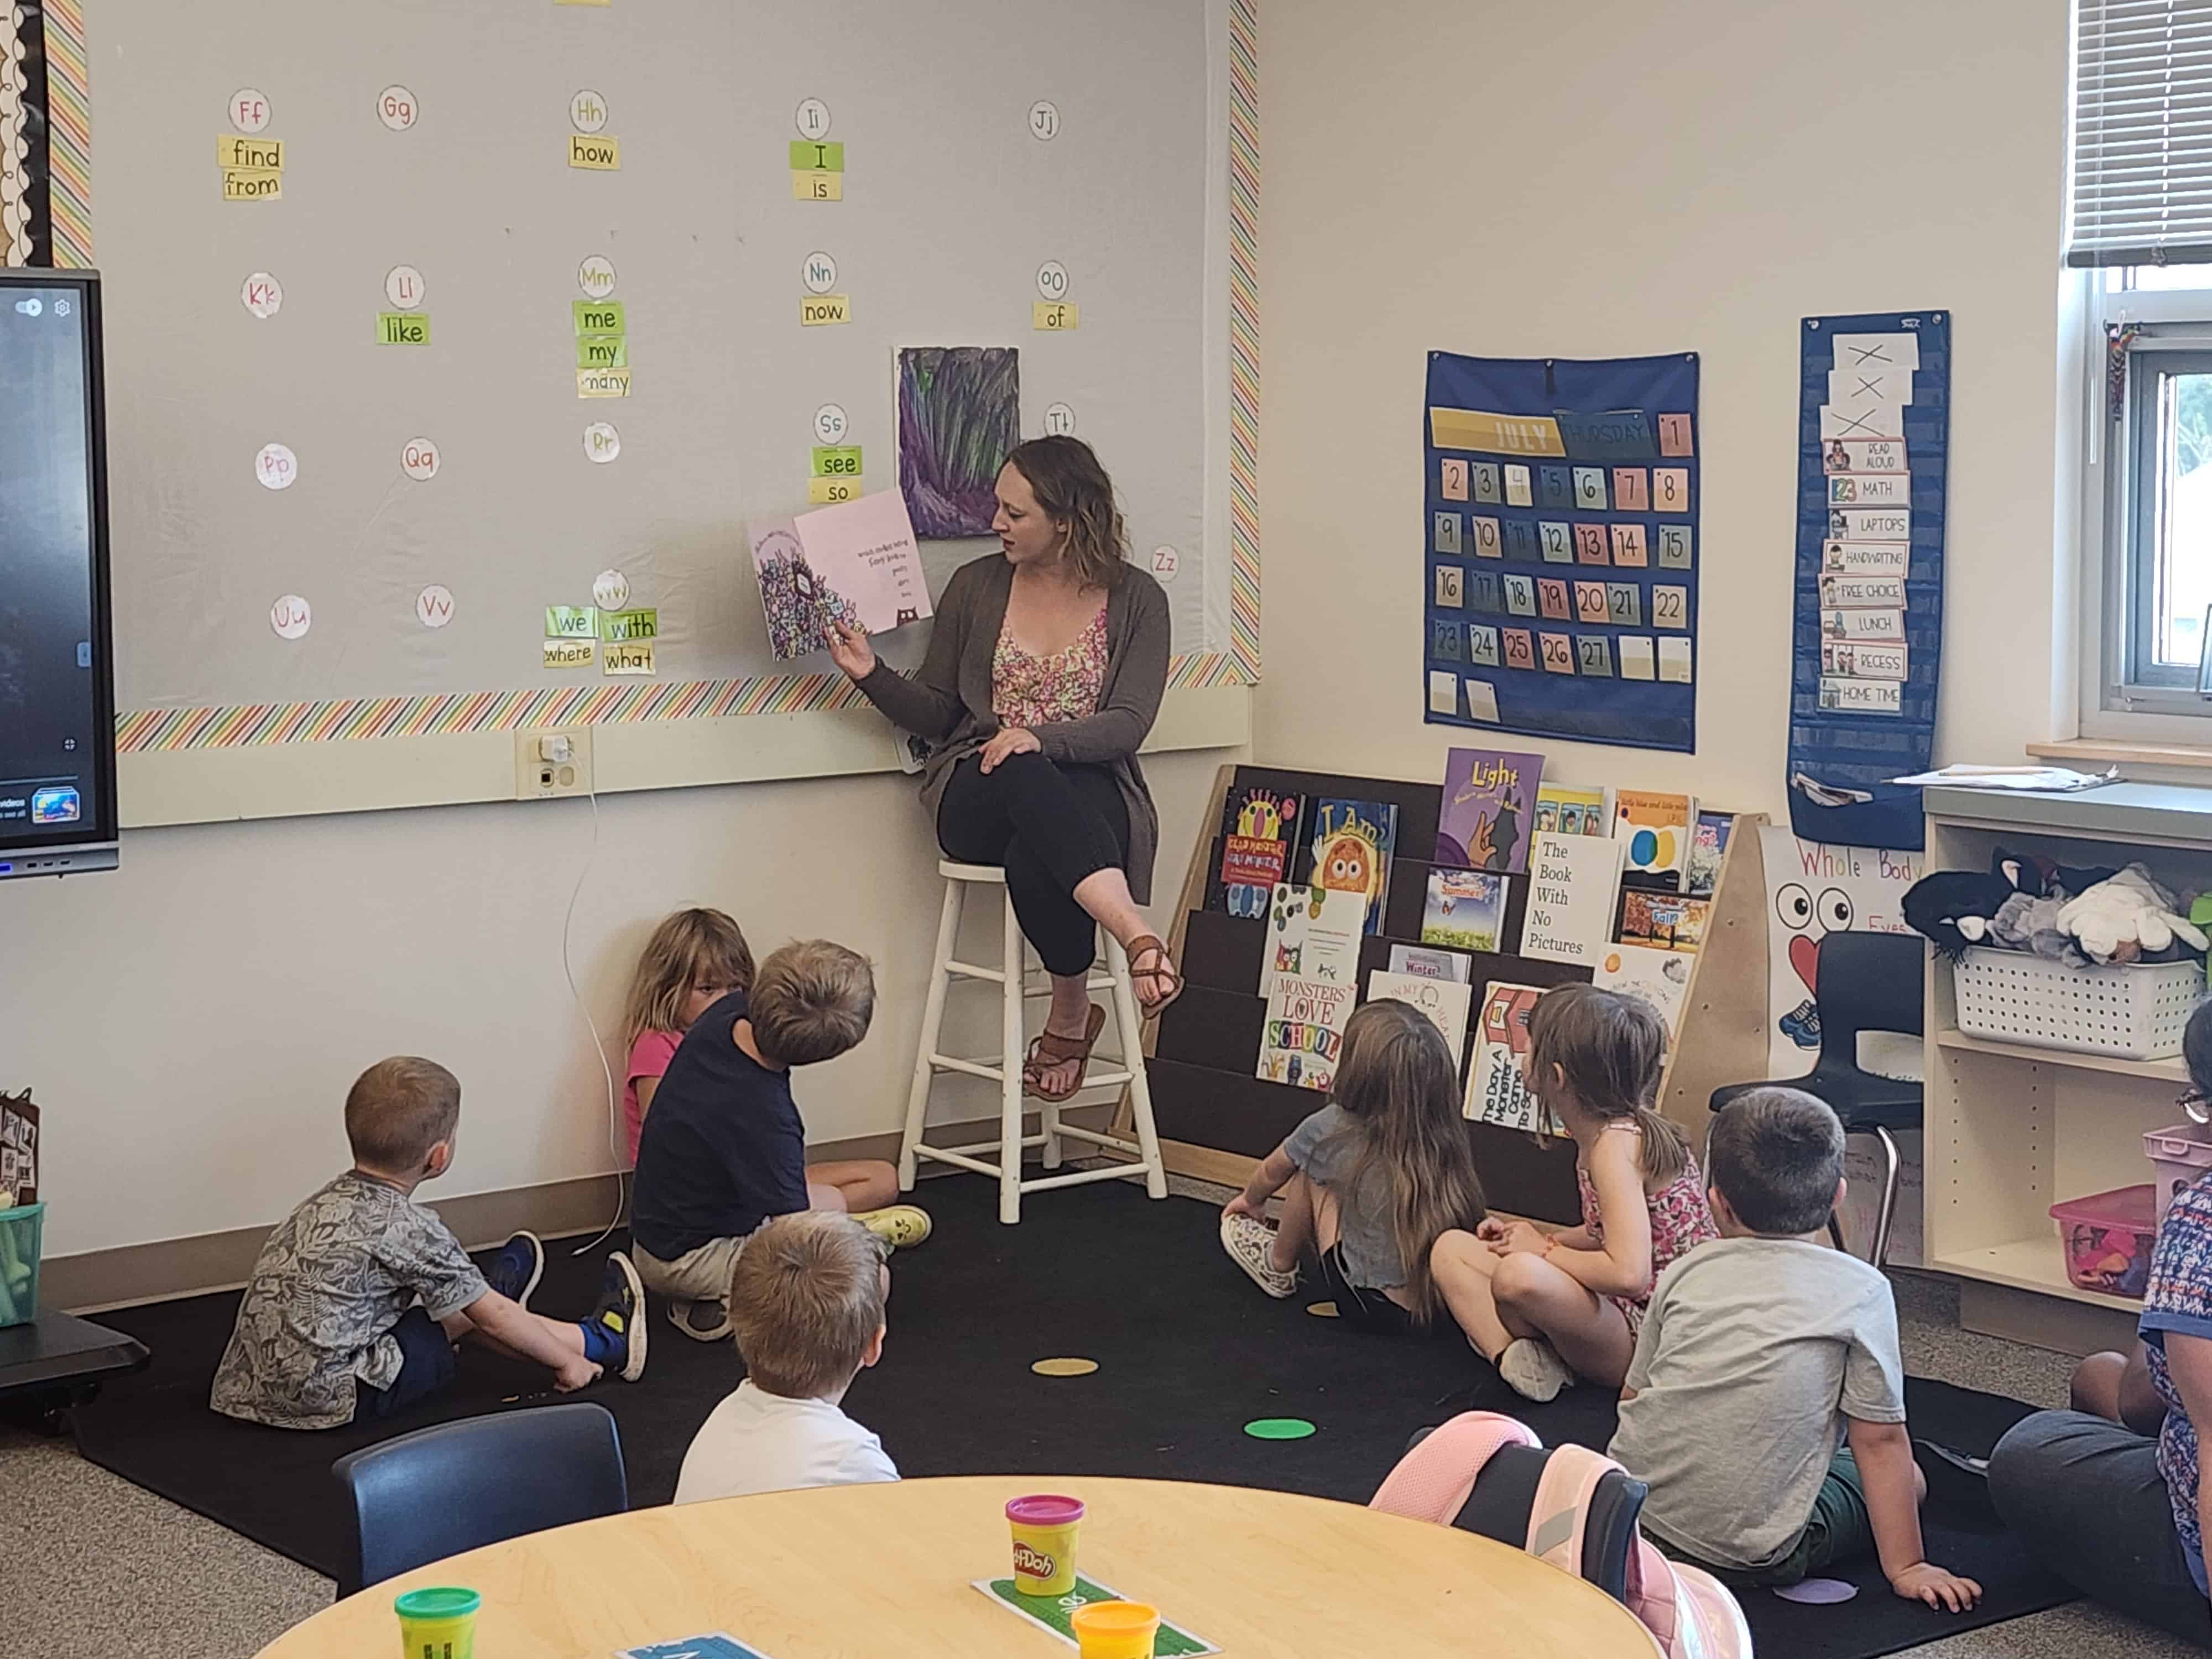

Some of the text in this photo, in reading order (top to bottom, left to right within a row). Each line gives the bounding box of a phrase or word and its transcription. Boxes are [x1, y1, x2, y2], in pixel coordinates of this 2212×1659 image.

[238, 101, 264, 124] Ff
[383, 96, 411, 125] Gg
[577, 100, 603, 122] Hh
[807, 108, 819, 130] Ii
[1035, 110, 1053, 135] Jj
[232, 139, 280, 169] find
[572, 136, 614, 165] how
[815, 145, 827, 169] I
[225, 173, 279, 196] from
[812, 179, 827, 198] is
[581, 267, 614, 288] Mm
[810, 262, 832, 283] Nn
[249, 283, 276, 306] Kk
[584, 310, 617, 330] me
[805, 302, 844, 321] now
[1047, 305, 1066, 327] of
[385, 317, 424, 344] like
[588, 342, 618, 368] my
[585, 373, 629, 397] many
[820, 414, 842, 433] Ss
[1050, 413, 1069, 432] Tt
[1670, 419, 1680, 447] 1
[1494, 421, 1547, 451] JULY
[405, 447, 434, 473] Qq
[1868, 443, 1890, 455] READ
[264, 456, 289, 483] Pp
[823, 455, 857, 475] see
[1866, 456, 1895, 469] ALOUD
[827, 484, 849, 501] so
[1449, 466, 1675, 502] 2 3 4 5 6 7 8
[1862, 482, 1893, 497] MATH
[1860, 518, 1906, 532] LAPTOPS
[1442, 518, 1684, 558] 9 10 11 12 13 14 15
[1155, 553, 1175, 572] Zz
[1845, 553, 1903, 566] HANDWRITING
[1441, 572, 1680, 618] 16 17 18 19 20 21 22
[1841, 584, 1900, 598] FREE CHOICE
[422, 595, 451, 617] Vv
[559, 614, 588, 633] we
[611, 614, 655, 639] with
[1859, 617, 1892, 632] LUNCH
[544, 646, 591, 663] where
[1437, 626, 1603, 667] 23 24 25 26 27
[605, 648, 653, 670] what
[1861, 653, 1901, 671] RECESS
[1843, 687, 1899, 703] HOME TIME
[1471, 758, 1518, 791] Light
[1321, 804, 1334, 843] I
[1542, 841, 1568, 859] The
[1796, 838, 1923, 881] Whole Body
[1539, 864, 1572, 883] Book
[1536, 886, 1568, 906] With
[1531, 910, 1552, 927] No
[1528, 932, 1584, 955] Pictures
[1278, 978, 1346, 1003] MONSTERS
[1282, 995, 1336, 1026] LOVE
[1269, 1021, 1342, 1062] SCHOOL
[1481, 1050, 1503, 1124] The Day A
[1494, 1057, 1512, 1123] Monster
